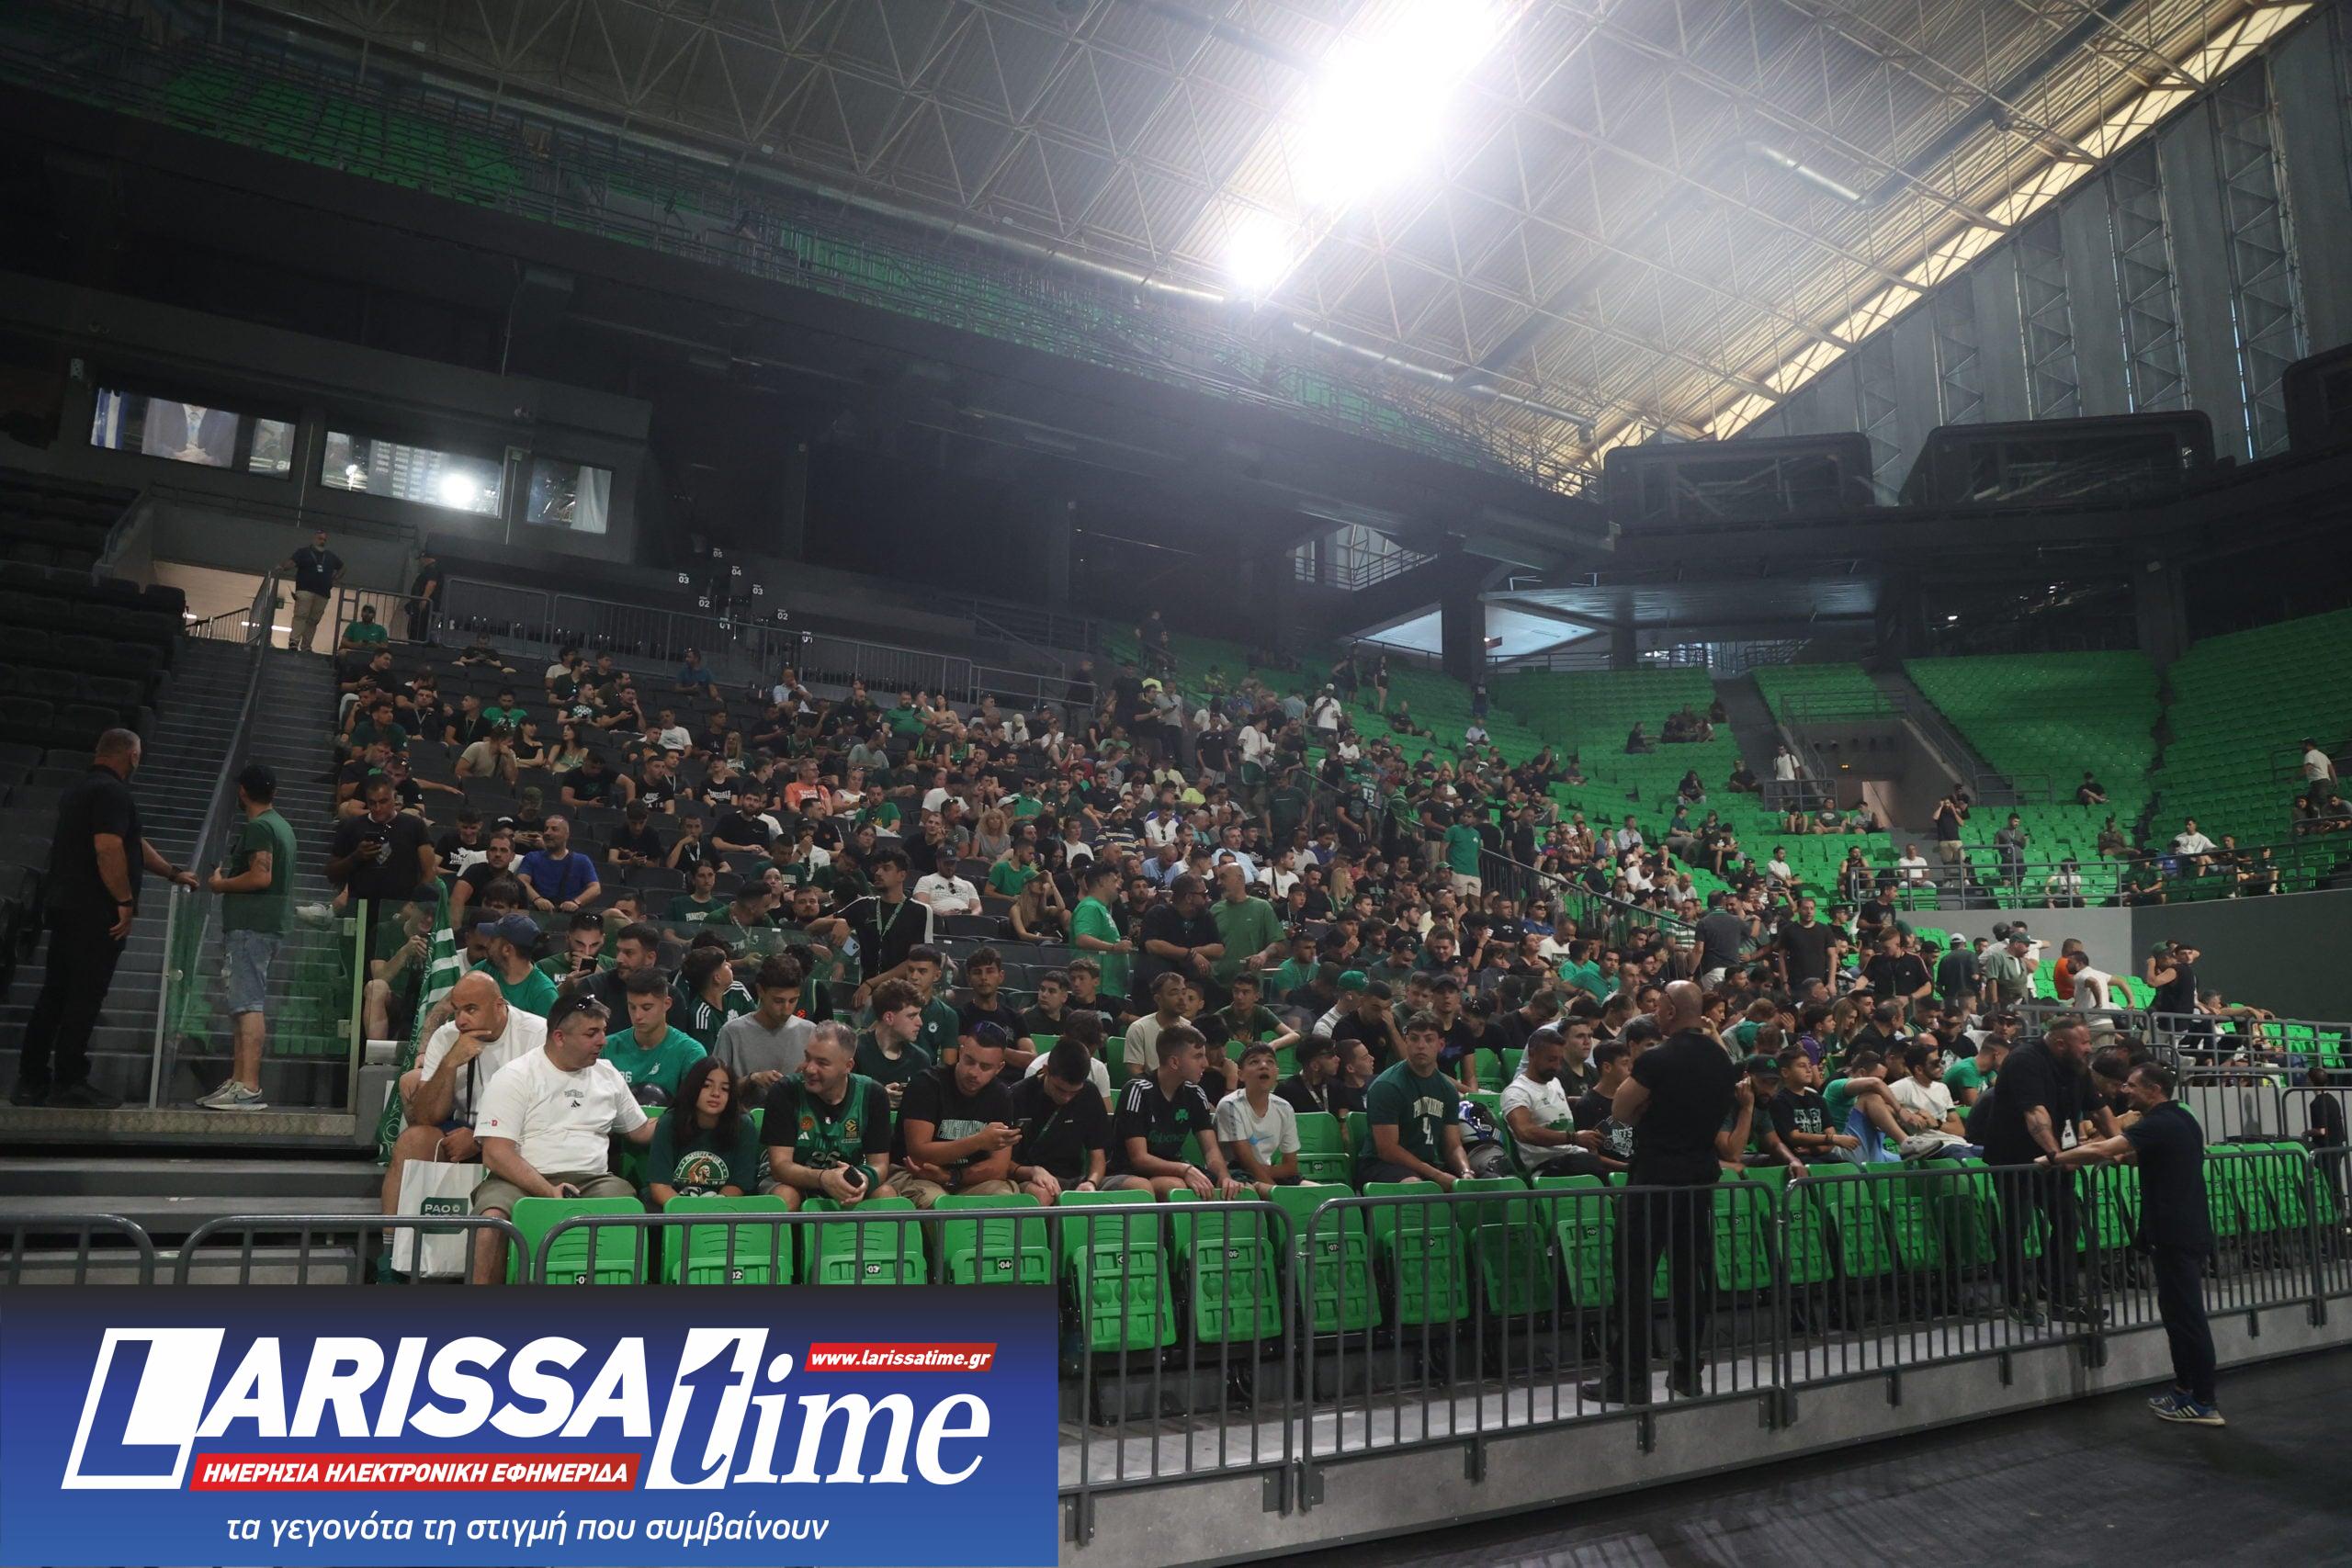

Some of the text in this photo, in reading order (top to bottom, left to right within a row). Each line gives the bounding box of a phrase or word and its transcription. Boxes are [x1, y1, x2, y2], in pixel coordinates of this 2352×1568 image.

[731, 569, 742, 577] 04
[678, 576, 690, 584] 03
[752, 587, 763, 595] 03
[698, 599, 710, 608] 02
[777, 613, 788, 621] 02
[424, 1204, 450, 1213] PAO
[1000, 1260, 1012, 1269] 04
[867, 1265, 879, 1274] 03
